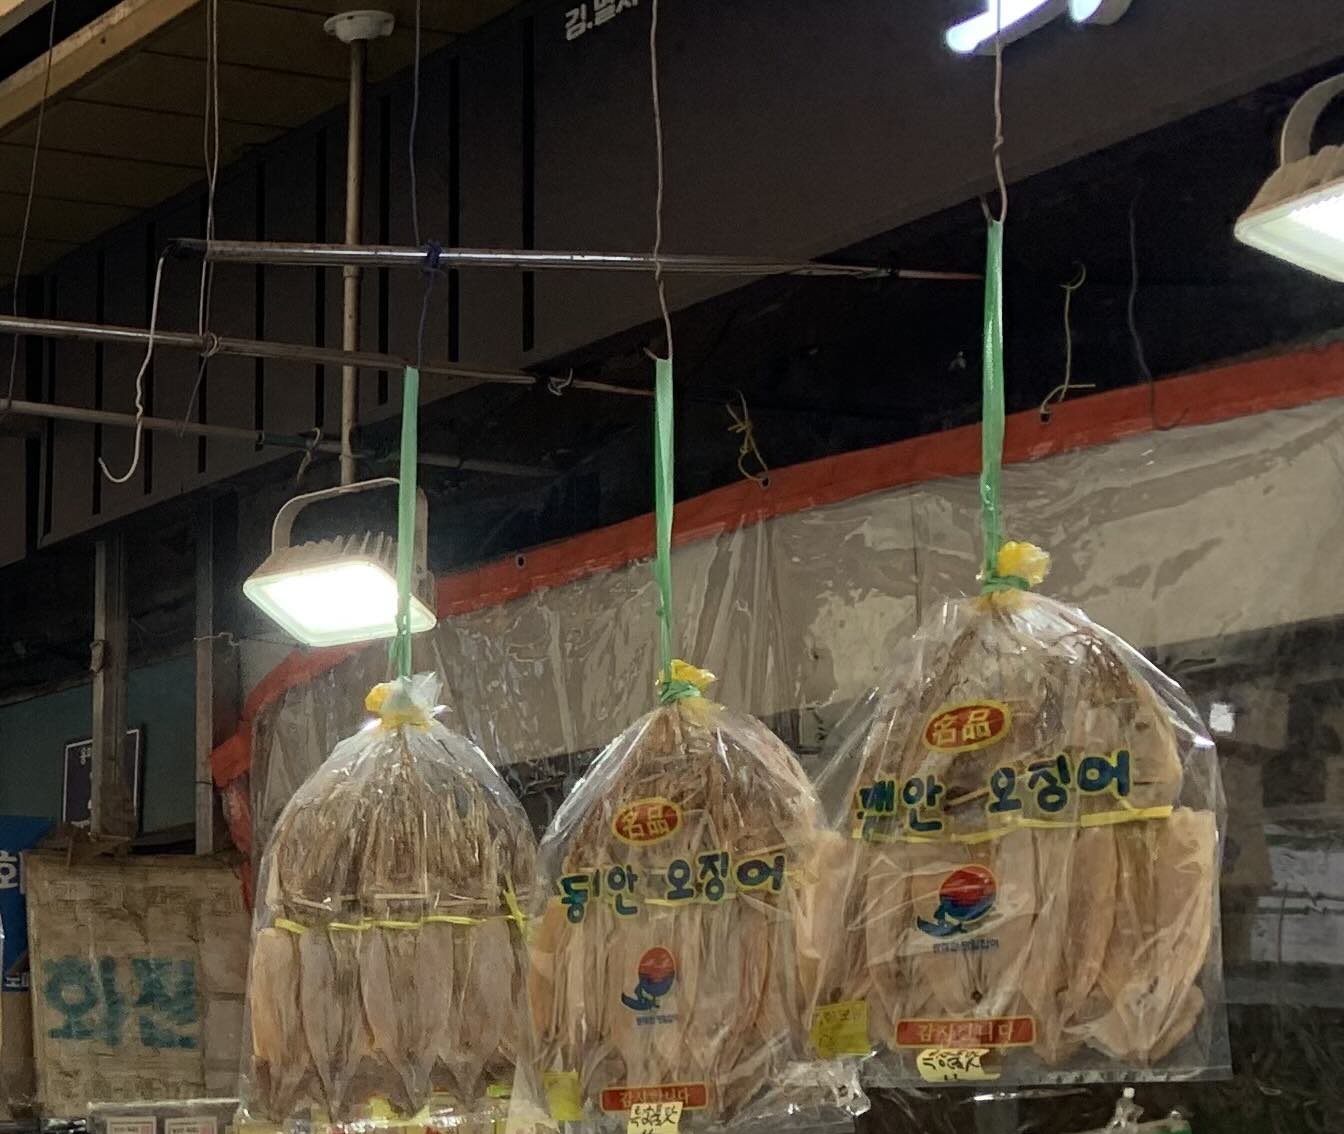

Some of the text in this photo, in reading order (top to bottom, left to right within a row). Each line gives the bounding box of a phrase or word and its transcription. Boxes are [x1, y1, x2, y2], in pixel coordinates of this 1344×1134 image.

[930, 709, 993, 743] 名品
[988, 749, 1131, 814] 오징어
[618, 804, 680, 842] 名品
[666, 851, 786, 902] 오징어
